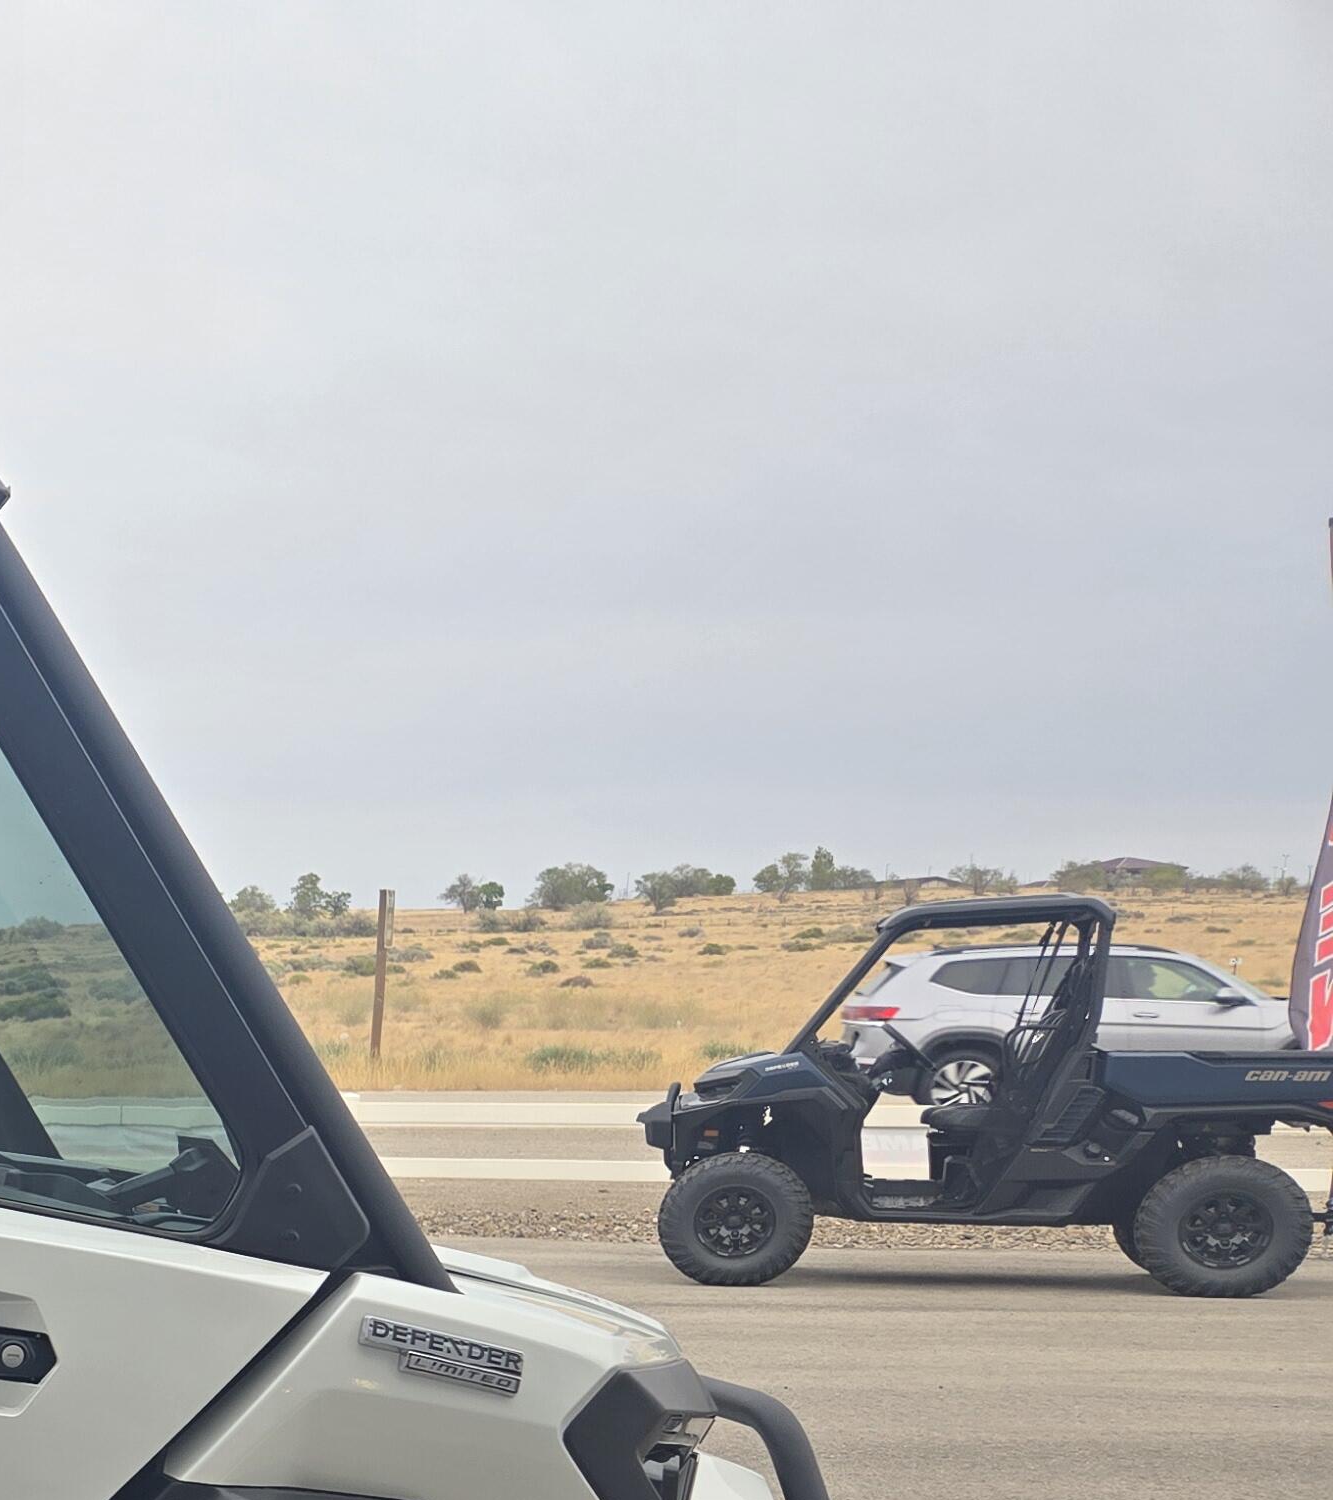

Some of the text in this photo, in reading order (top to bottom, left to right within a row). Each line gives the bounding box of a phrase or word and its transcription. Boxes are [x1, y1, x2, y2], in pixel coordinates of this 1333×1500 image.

[1244, 1070, 1332, 1082] can-am
[369, 1320, 523, 1371] DEFENDER
[413, 1358, 513, 1389] LIMITED
